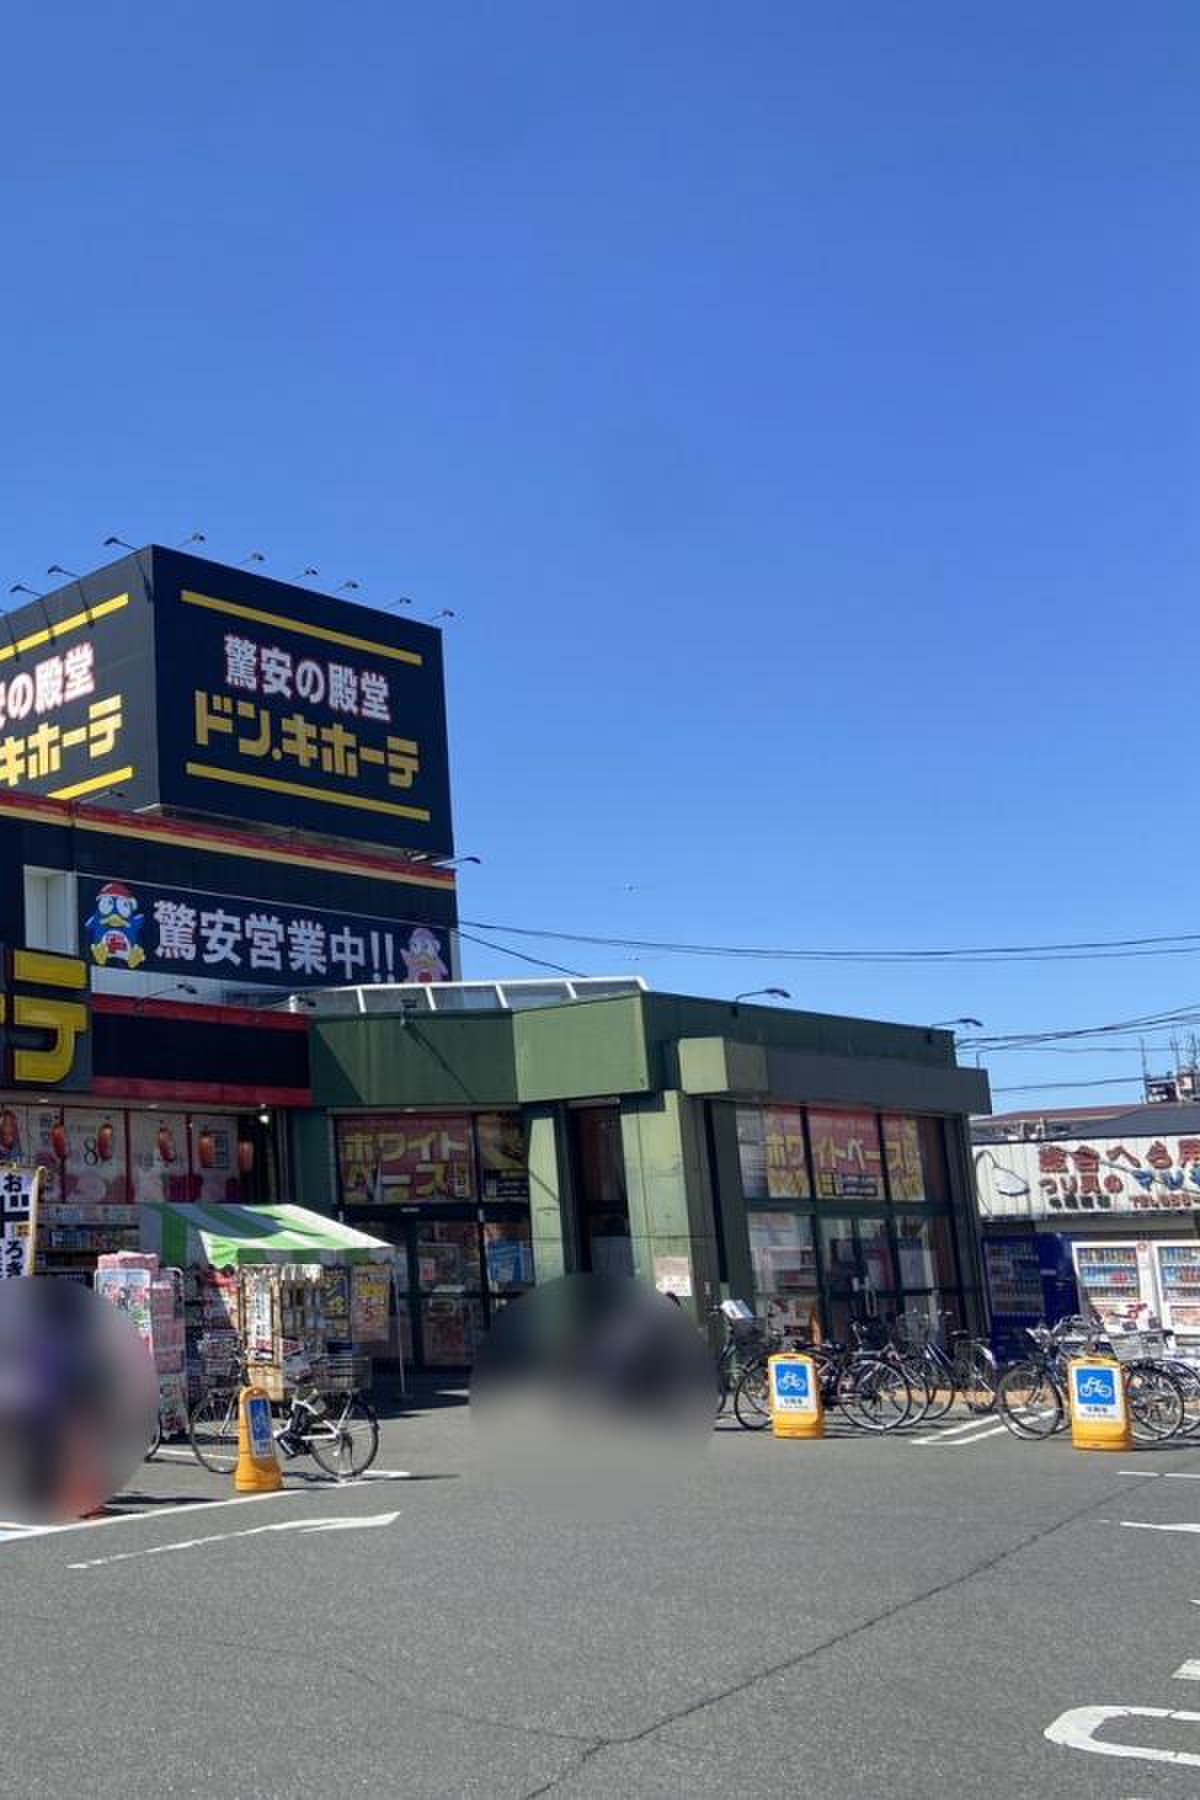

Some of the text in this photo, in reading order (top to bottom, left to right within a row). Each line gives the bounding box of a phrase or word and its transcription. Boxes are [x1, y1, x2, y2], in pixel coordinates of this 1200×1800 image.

[223, 634, 392, 722] 驚安の殿堂
